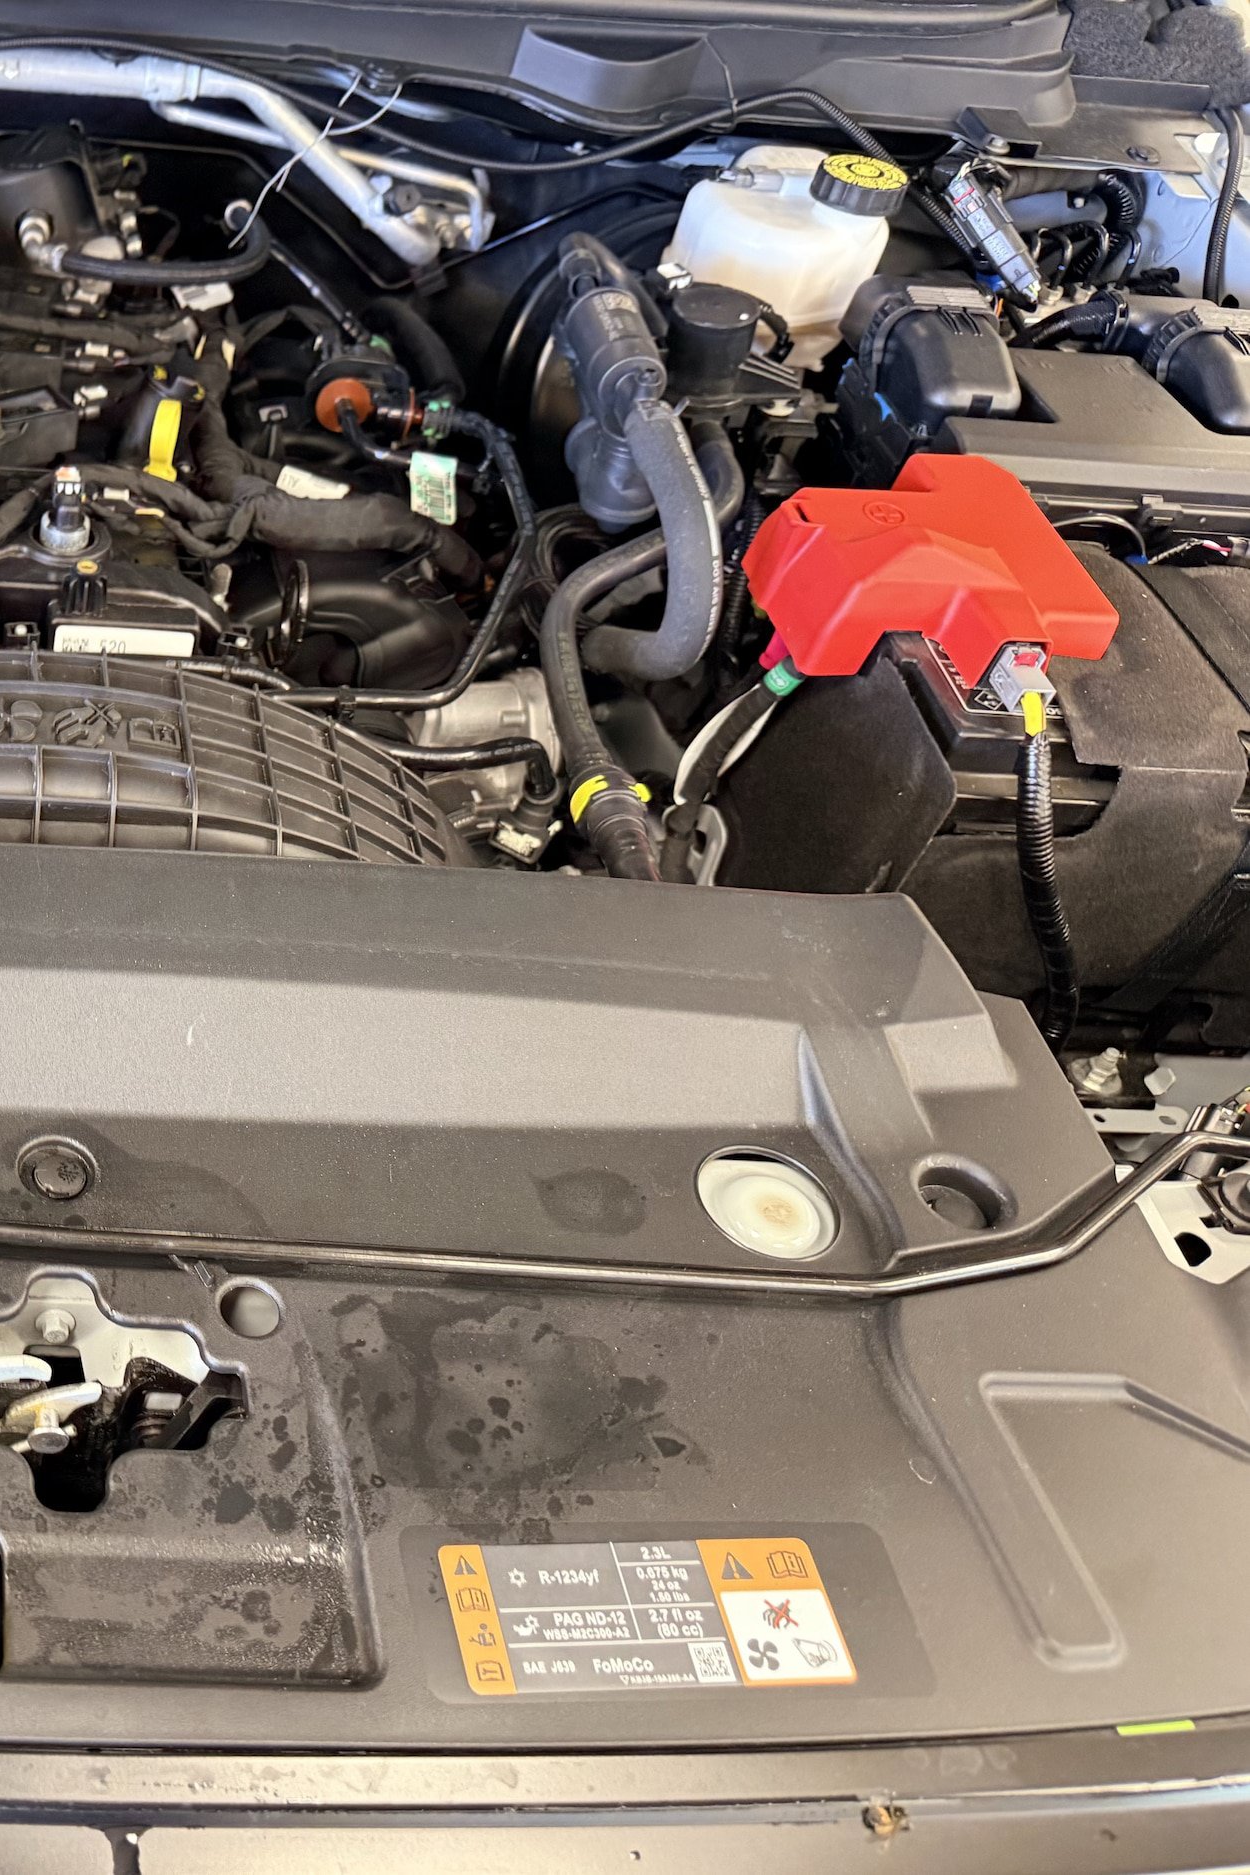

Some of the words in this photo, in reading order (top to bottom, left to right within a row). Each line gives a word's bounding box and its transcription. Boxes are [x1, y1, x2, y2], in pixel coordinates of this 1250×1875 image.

[640, 1546, 672, 1560] 2.3L
[538, 1569, 600, 1587] R-1234yf
[672, 1565, 689, 1581] kg
[667, 1581, 681, 1590] oz
[553, 1612, 582, 1627] PAG
[586, 1611, 627, 1626] ND-12
[648, 1609, 668, 1623] 2.7
[671, 1608, 683, 1621] fl
[686, 1610, 704, 1622] oz
[657, 1623, 680, 1639] (80
[682, 1623, 704, 1638] cc)
[592, 1656, 655, 1674] FoMoCo
